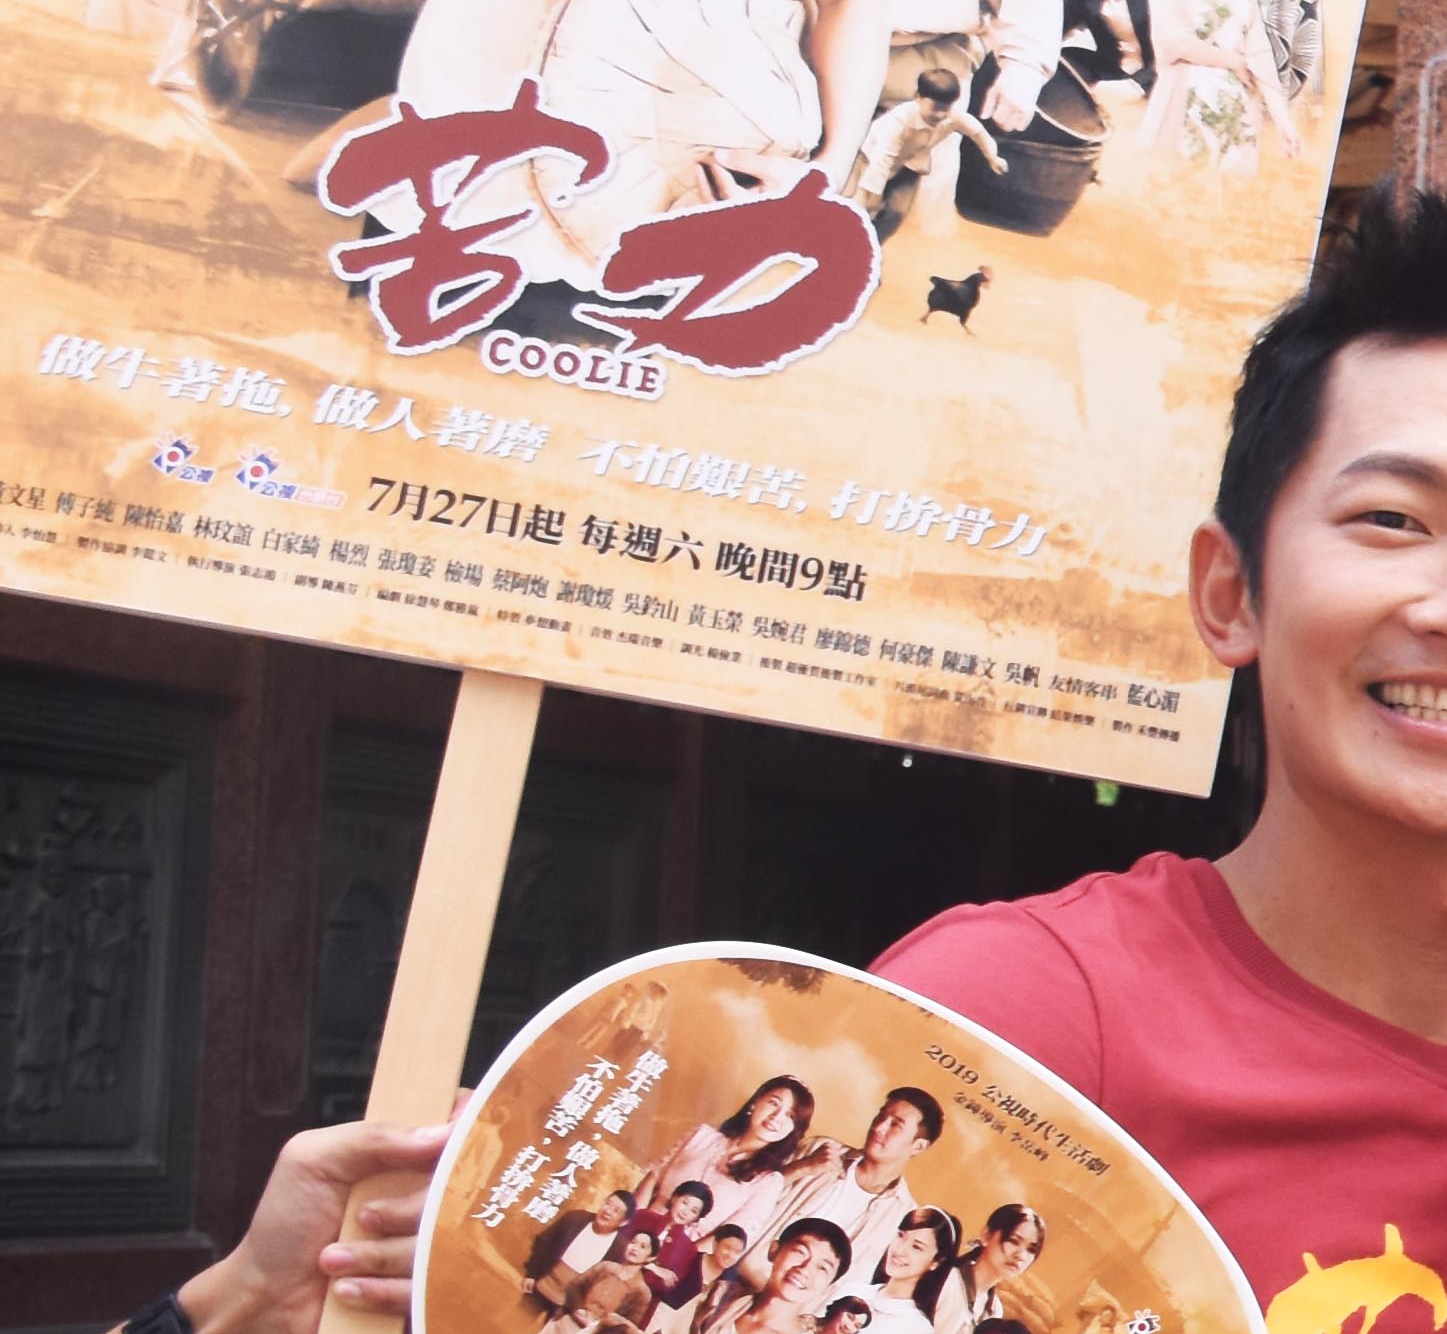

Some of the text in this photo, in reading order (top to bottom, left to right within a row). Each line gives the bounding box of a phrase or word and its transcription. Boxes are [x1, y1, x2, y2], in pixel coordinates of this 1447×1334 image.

[324, 77, 876, 369] 苦力
[487, 336, 662, 393] COOLIE
[367, 476, 868, 602] 7月27日起 每週六 晚間9點
[924, 1044, 1111, 1176] 2019 公視時代生活劇
